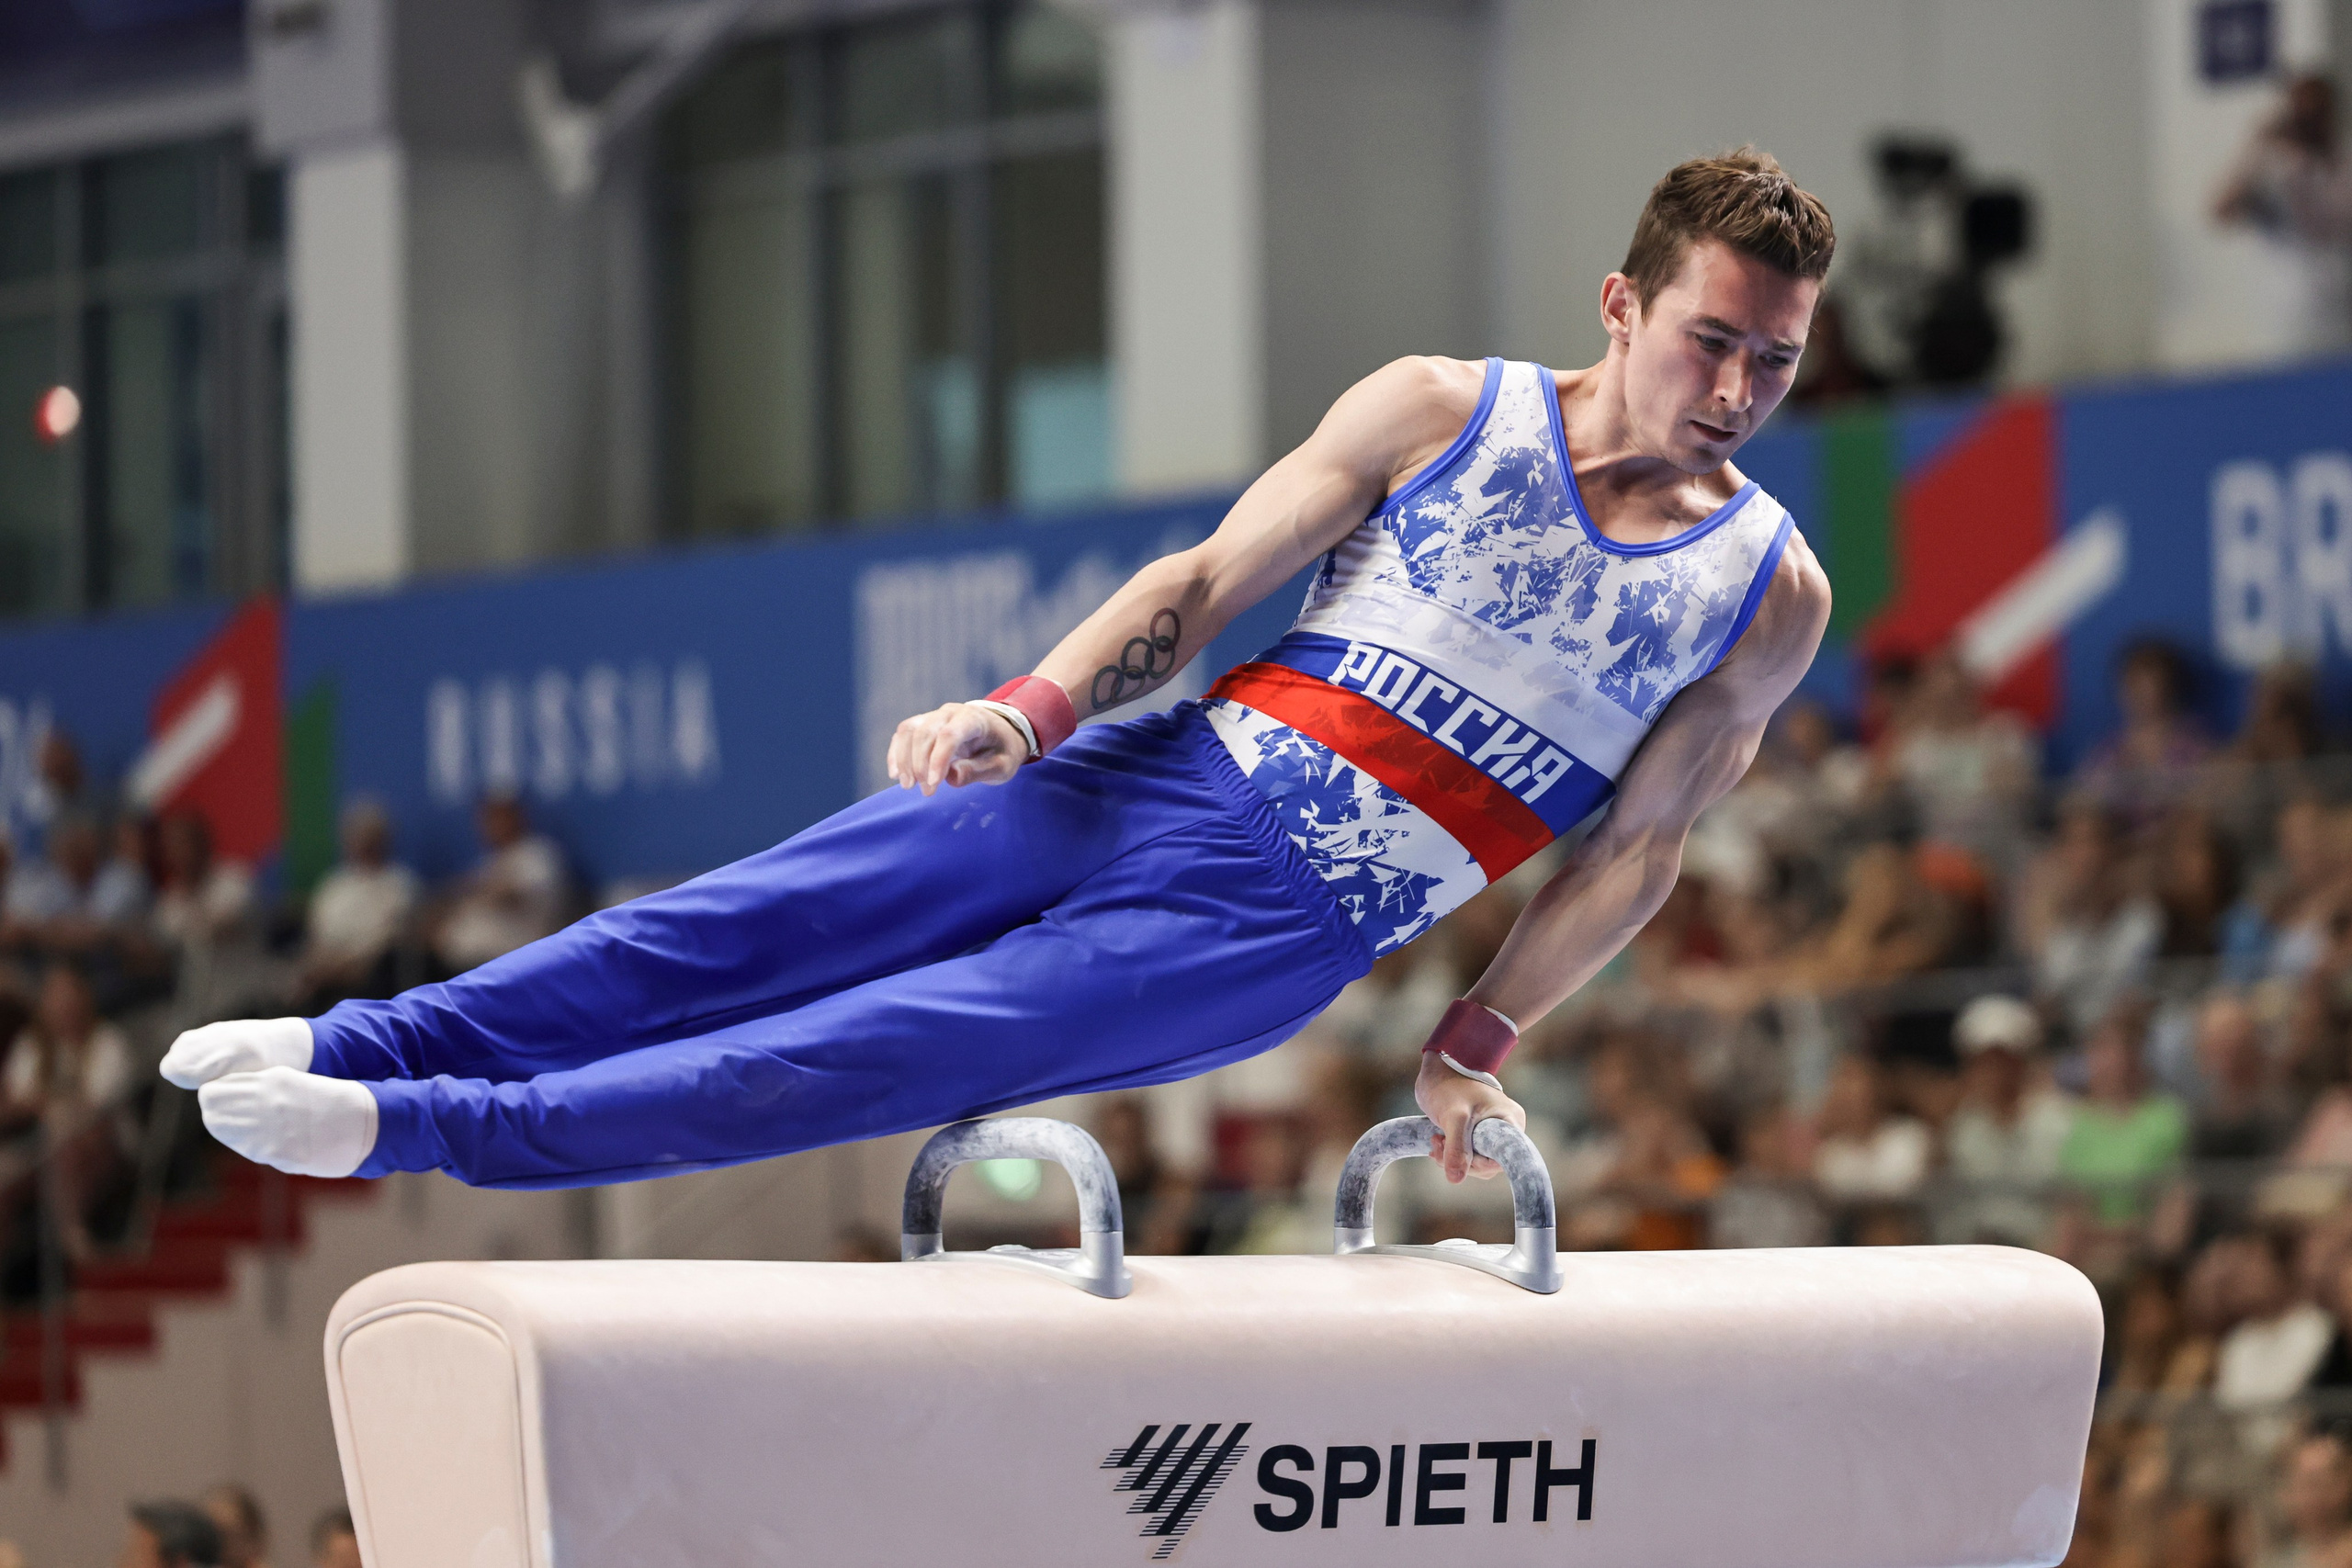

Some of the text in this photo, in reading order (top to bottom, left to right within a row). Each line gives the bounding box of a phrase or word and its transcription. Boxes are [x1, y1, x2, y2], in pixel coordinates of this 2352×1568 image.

[426, 660, 717, 799] RUSSIA
[1328, 640, 1575, 804] РОССИЯ
[1253, 1438, 1597, 1532] SPIETH
